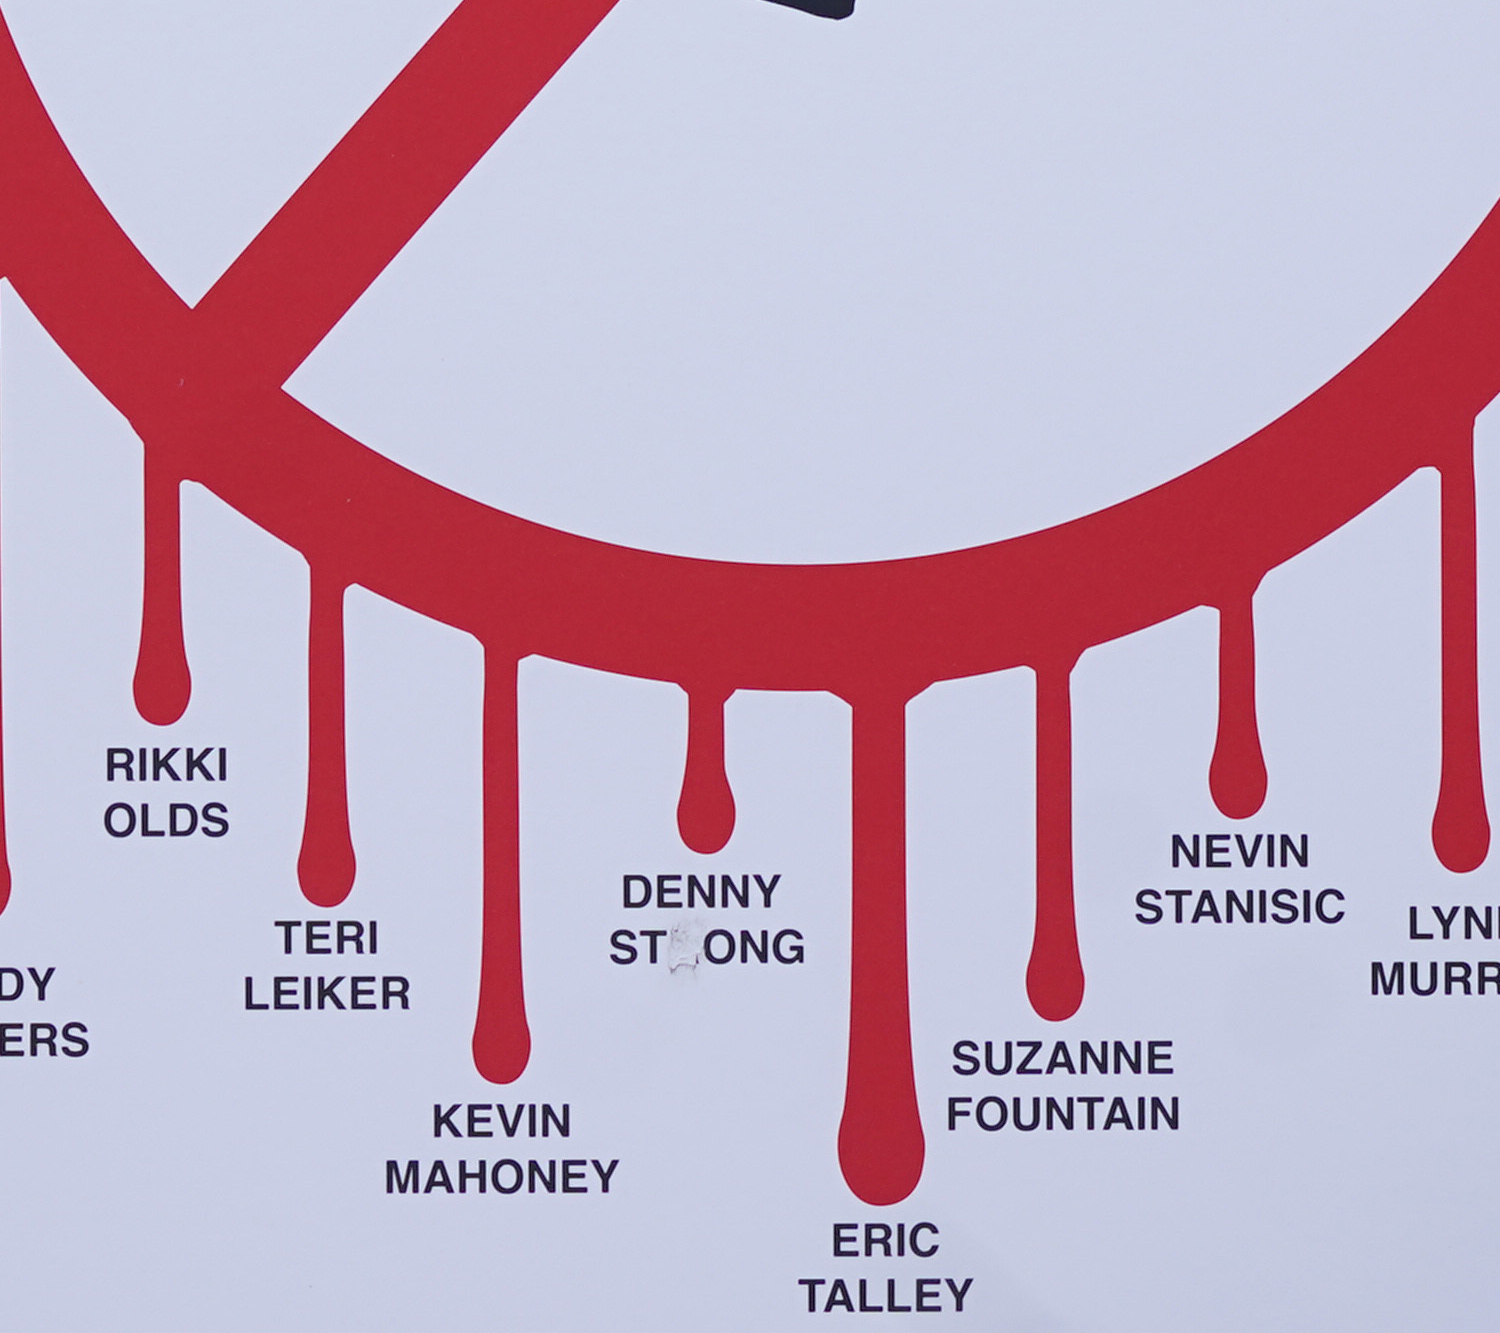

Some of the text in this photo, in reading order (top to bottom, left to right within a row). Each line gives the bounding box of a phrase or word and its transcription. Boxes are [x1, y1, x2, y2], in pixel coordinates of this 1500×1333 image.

[108, 748, 226, 781] RIKKI
[105, 803, 228, 837] OLDS
[1173, 835, 1307, 867] NEVIN
[624, 875, 780, 908] DENNY
[1136, 889, 1344, 924] STANISIC
[275, 921, 376, 954] TERI
[610, 929, 804, 964] STONG
[246, 977, 409, 1009] LEIKER
[953, 1041, 1173, 1075] SUZANNE
[435, 1104, 569, 1137] KEVIN
[949, 1097, 1178, 1131] FOUNTAIN
[387, 1159, 618, 1194] MAHONEY
[834, 1223, 938, 1257] ERIC
[799, 1279, 973, 1312] TALLEY
